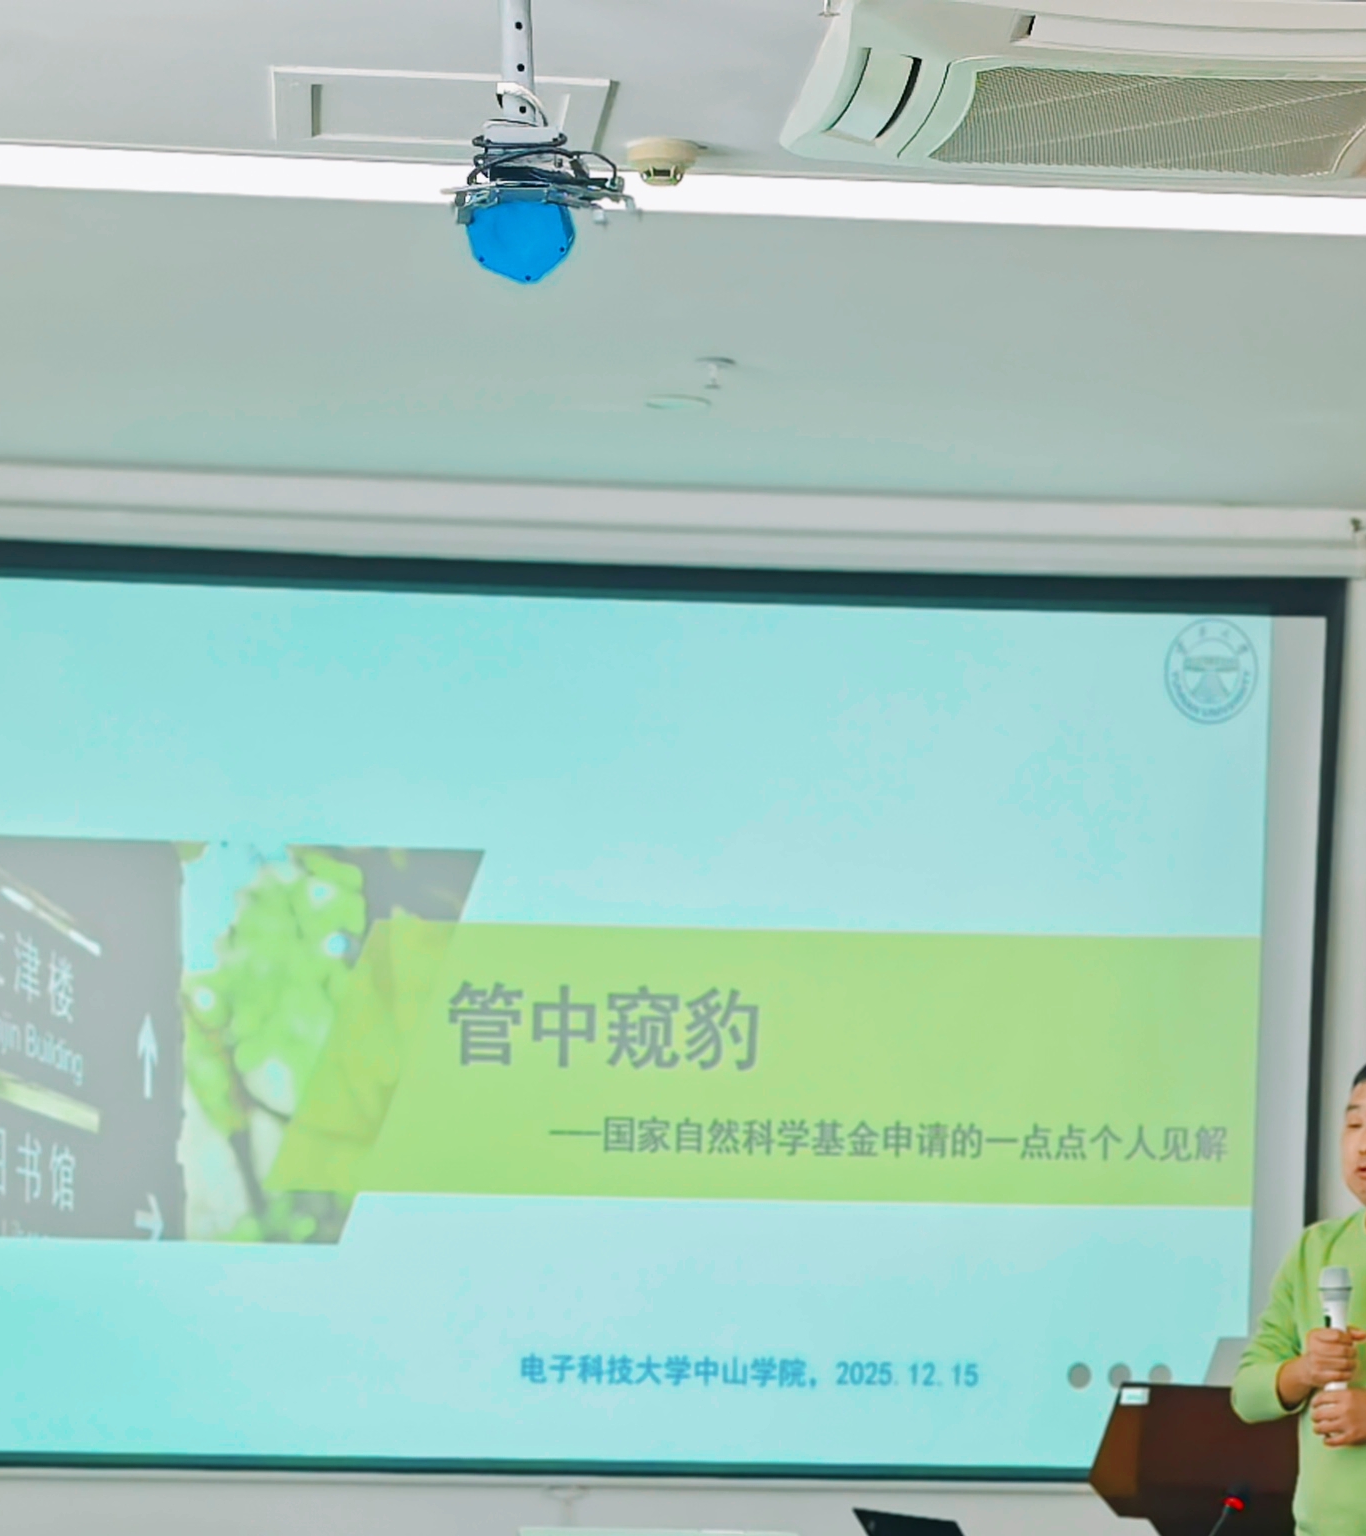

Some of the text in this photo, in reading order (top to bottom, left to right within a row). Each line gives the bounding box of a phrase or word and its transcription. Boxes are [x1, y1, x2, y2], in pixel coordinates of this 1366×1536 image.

[25, 1022, 85, 1086] Building
[448, 981, 761, 1072] 管中窥豹
